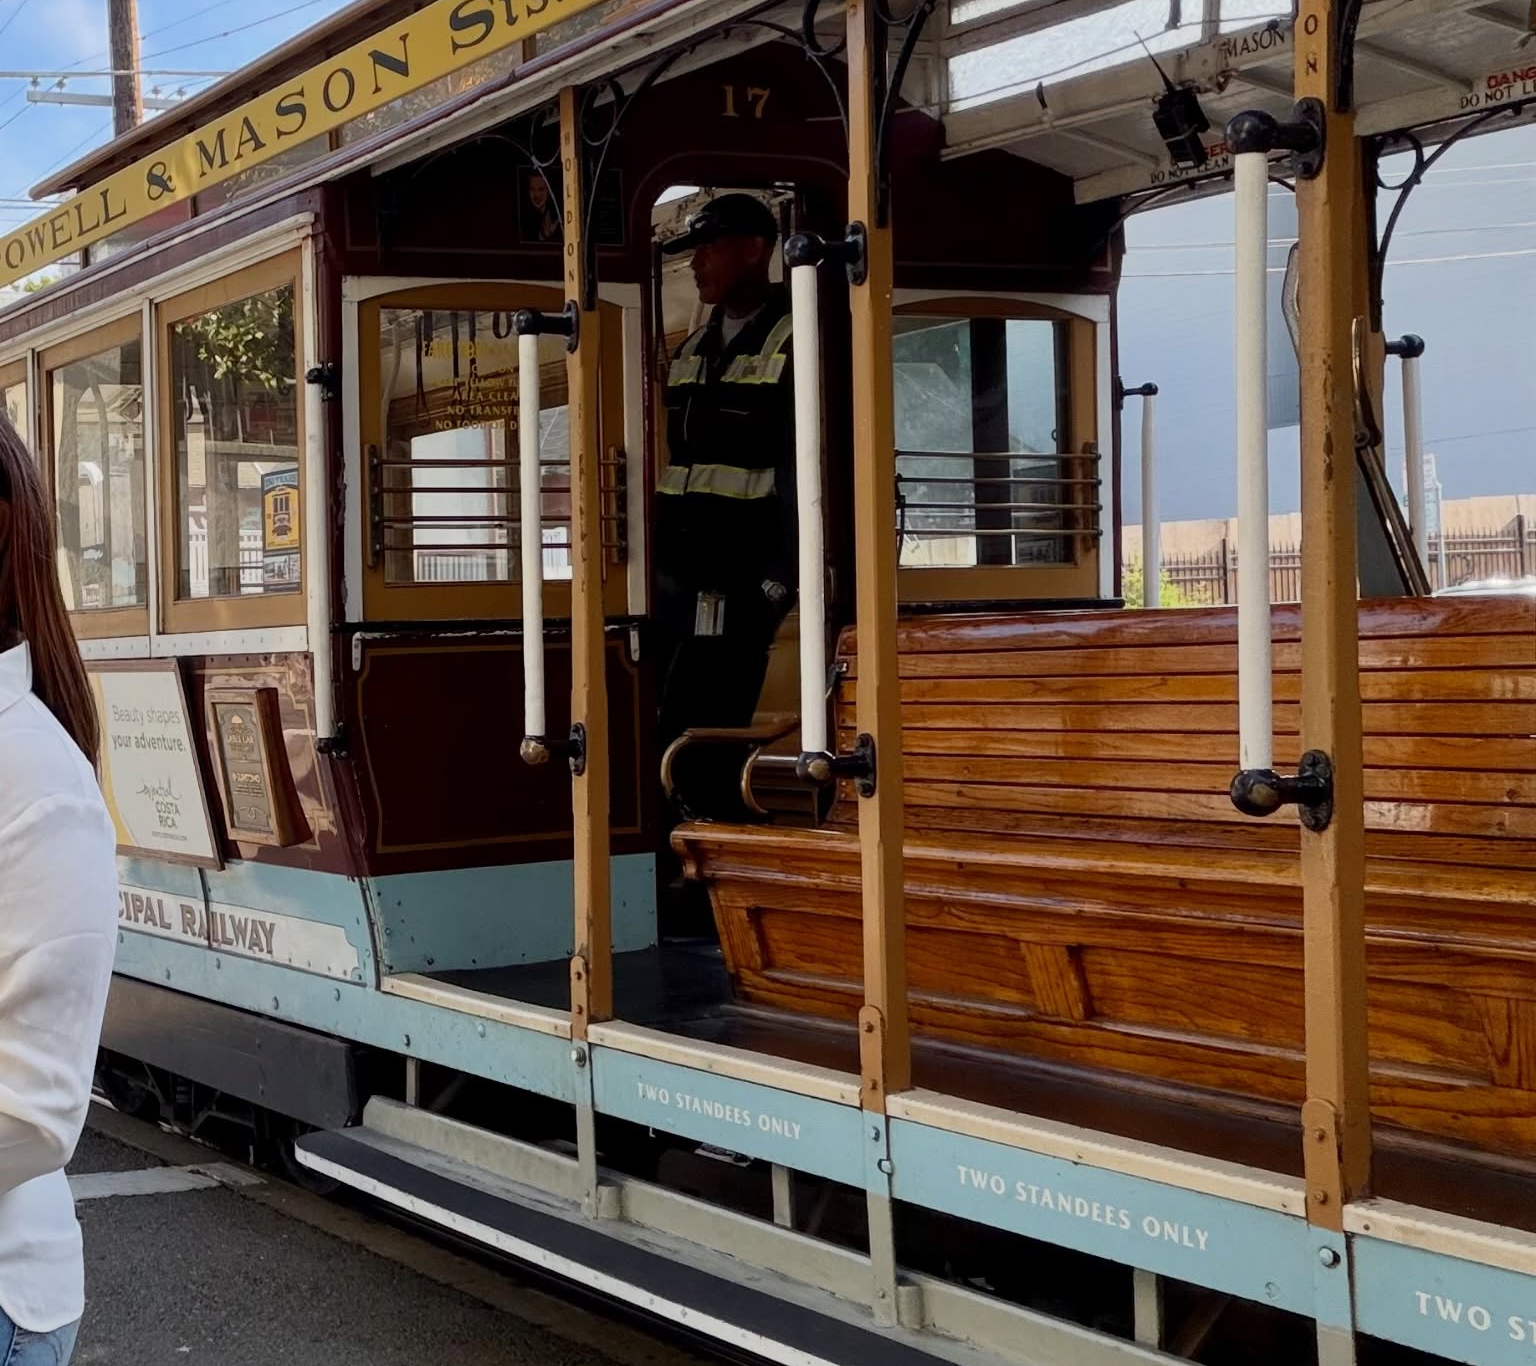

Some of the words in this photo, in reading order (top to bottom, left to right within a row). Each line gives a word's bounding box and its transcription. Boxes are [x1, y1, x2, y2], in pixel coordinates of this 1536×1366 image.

[1223, 29, 1285, 60] MASON
[1304, 14, 1319, 77] ON
[721, 84, 771, 120] 17
[1460, 93, 1480, 109] DO
[1485, 84, 1515, 105] NOT
[146, 160, 177, 202] &
[197, 34, 411, 178] MASON
[112, 705, 144, 727] Beauty
[147, 709, 180, 726] shapes
[112, 733, 132, 751] your
[134, 733, 187, 752] adventure.
[155, 801, 180, 815] COSTA
[158, 814, 178, 828] RICA
[179, 903, 276, 955] RAILWAY
[637, 1081, 670, 1106] TWO
[675, 1090, 752, 1126] STANDEES
[758, 1113, 802, 1141] ONLY
[957, 1165, 1008, 1197] TWO
[1014, 1181, 1132, 1231] STANDEES
[1141, 1214, 1210, 1252] ONLY
[1415, 1290, 1491, 1331] TWO
